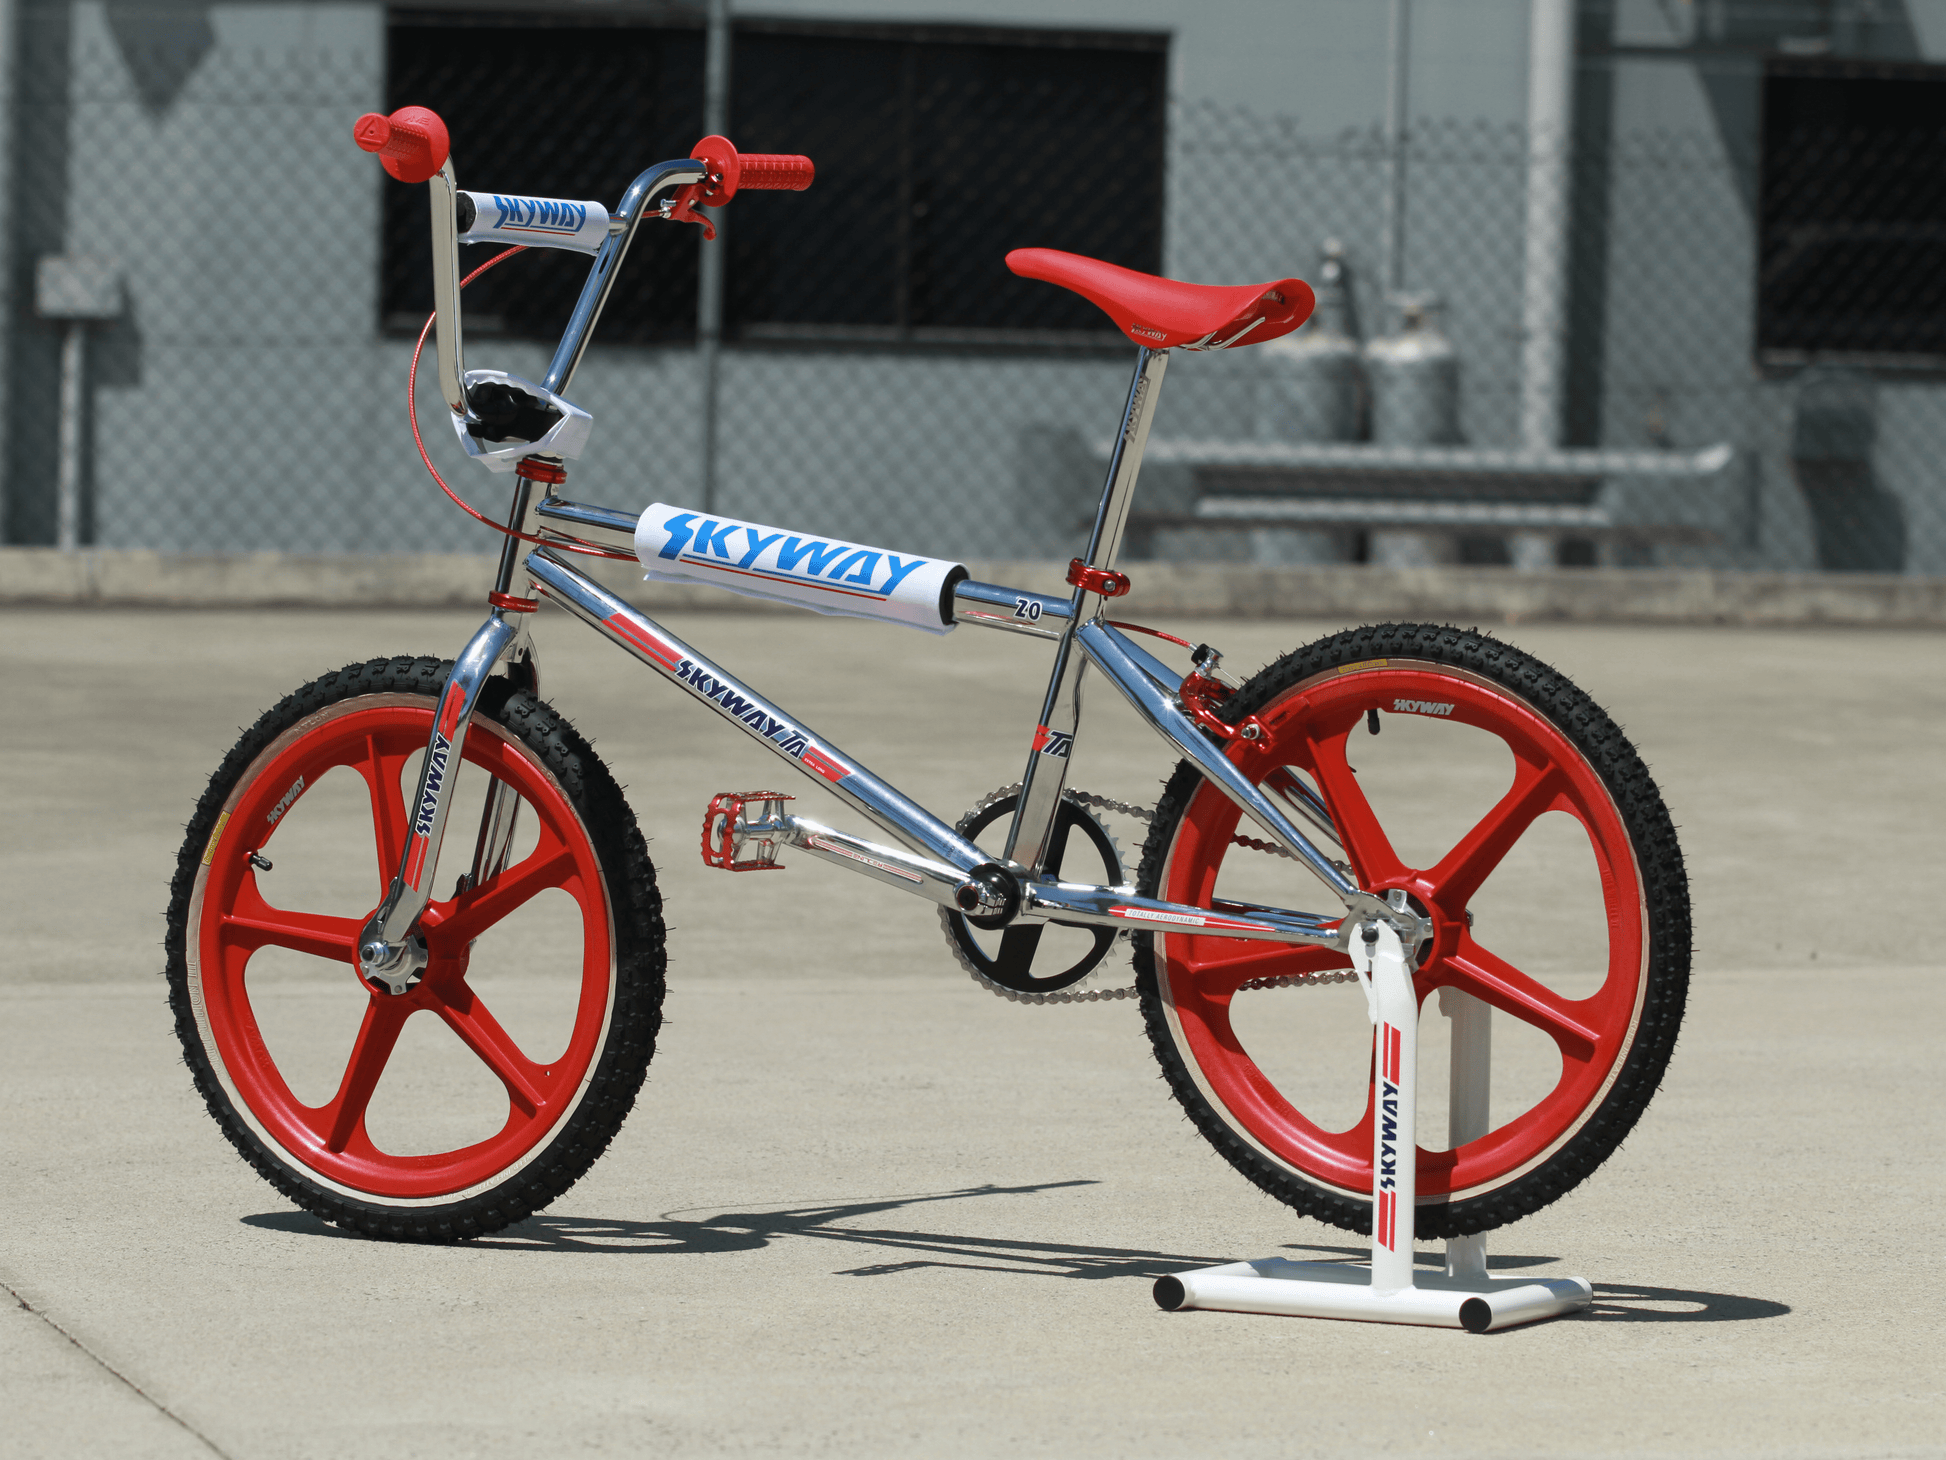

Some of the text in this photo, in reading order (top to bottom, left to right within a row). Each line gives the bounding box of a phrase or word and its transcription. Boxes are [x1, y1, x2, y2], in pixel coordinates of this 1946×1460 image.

[492, 195, 587, 233] SKYWAY
[658, 513, 929, 596] SKYWAY
[1013, 597, 1043, 621] 20
[674, 658, 789, 739] SKYWAY
[1393, 698, 1455, 716] SKYWAY
[266, 774, 305, 825] SKYWAY
[414, 732, 452, 837] SKYWAY
[1128, 909, 1200, 925] TOTALLY AERODYNAMIC
[1380, 1080, 1398, 1190] SKYWAY
